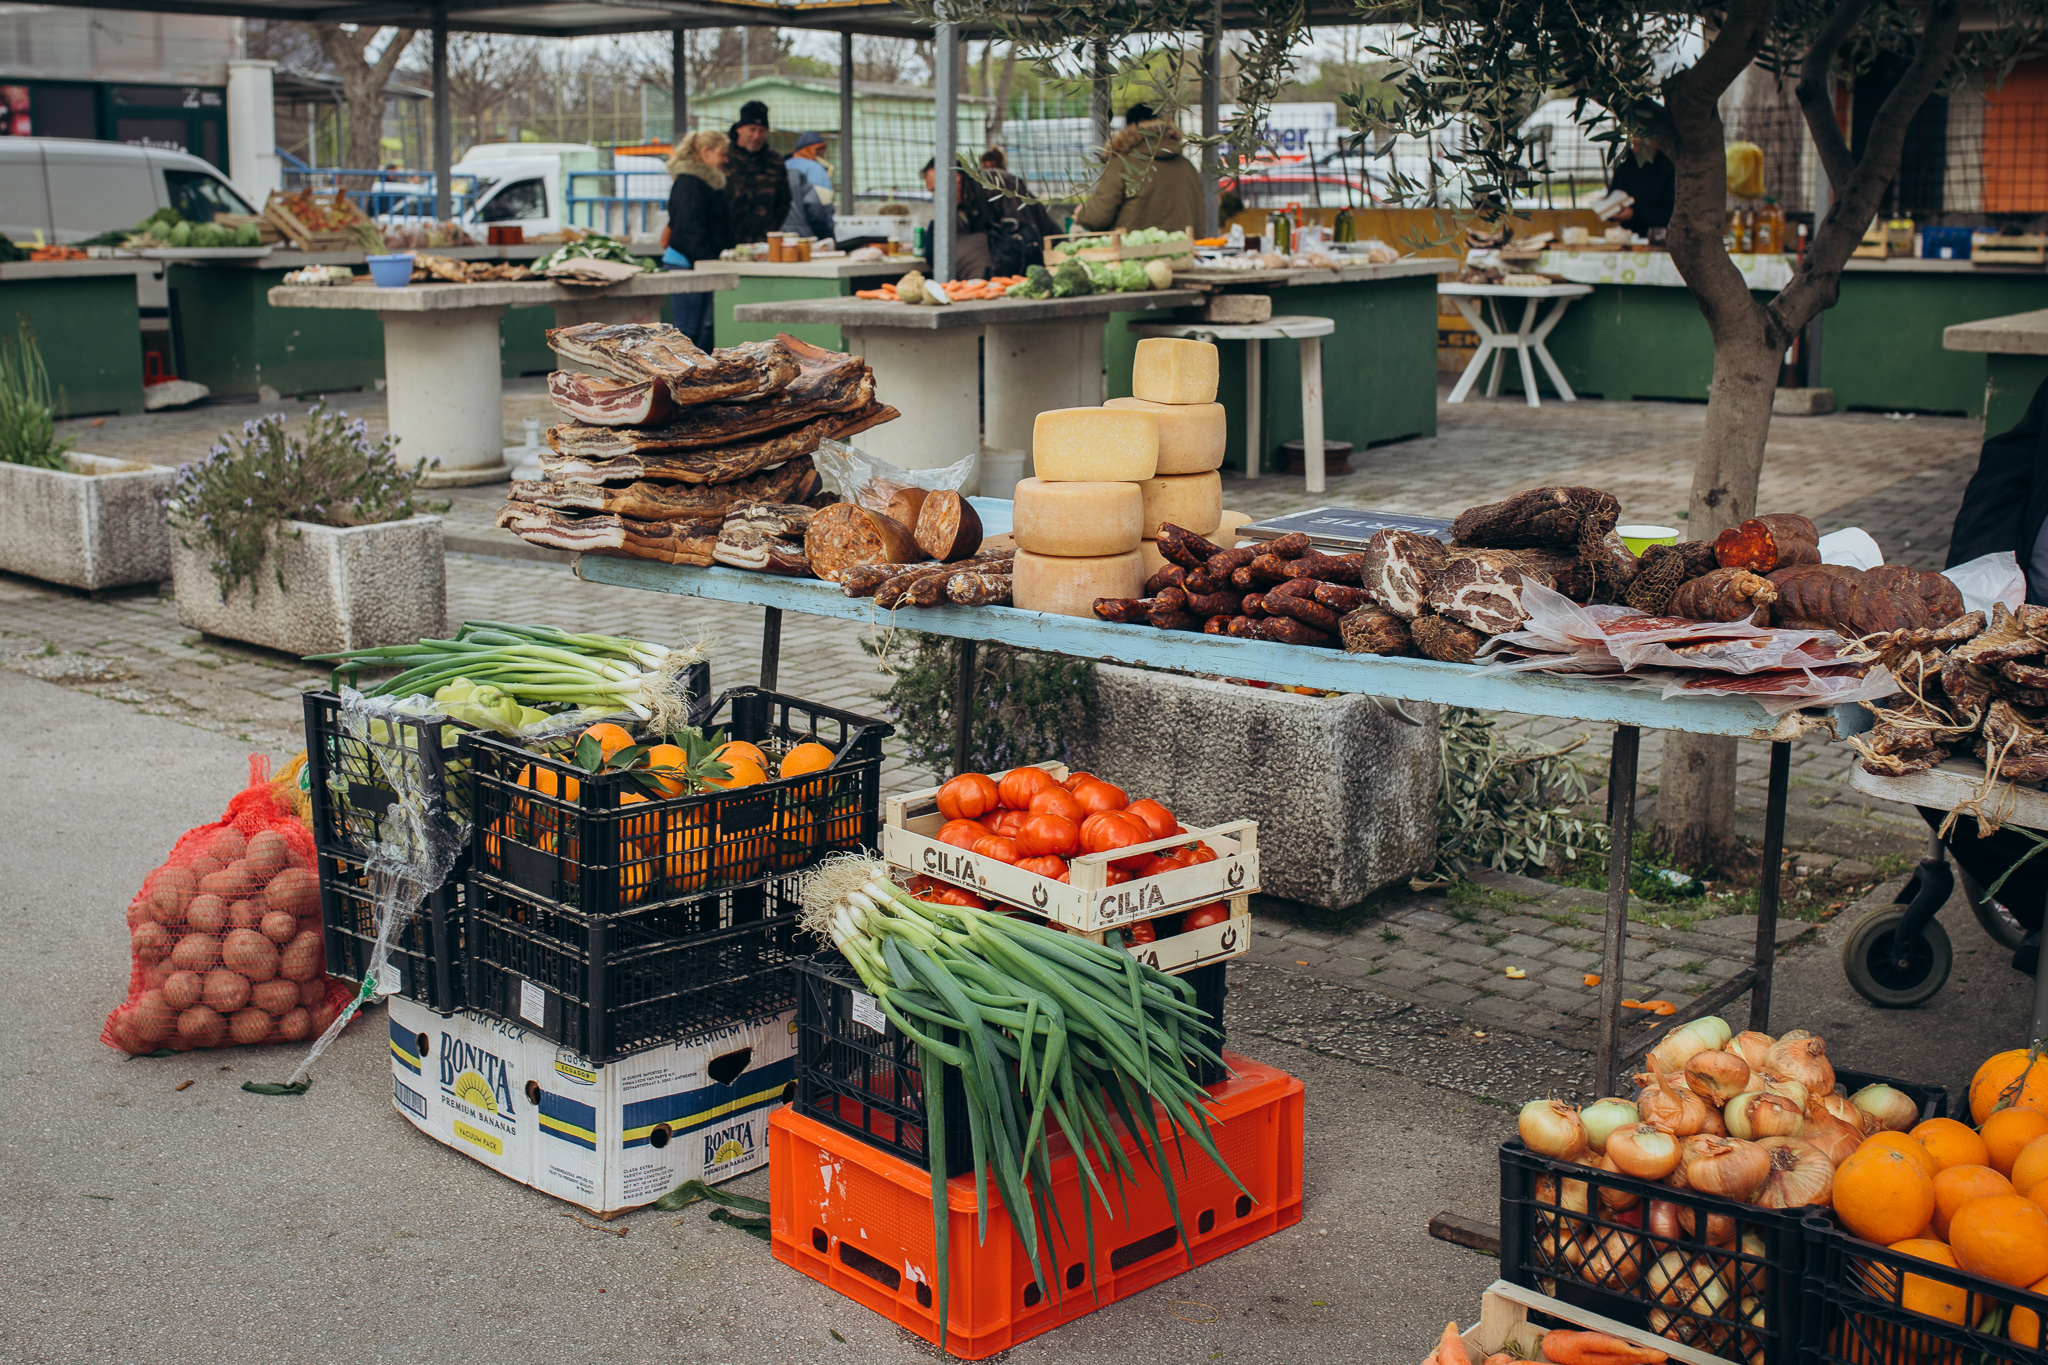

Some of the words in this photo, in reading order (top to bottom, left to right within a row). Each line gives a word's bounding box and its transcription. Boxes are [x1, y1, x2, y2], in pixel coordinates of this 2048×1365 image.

[440, 1030, 516, 1115] BONITA
[562, 1054, 586, 1068] 100%
[562, 1064, 590, 1078] ECUADOR
[441, 1094, 476, 1118] PREMIUM
[479, 1112, 516, 1136] BANANAS
[459, 1127, 481, 1142] VACUUM
[483, 1138, 497, 1150] PACK
[704, 1121, 754, 1165] BONITA
[704, 1162, 728, 1176] PREMIUM
[730, 1154, 754, 1167] BANANAS
